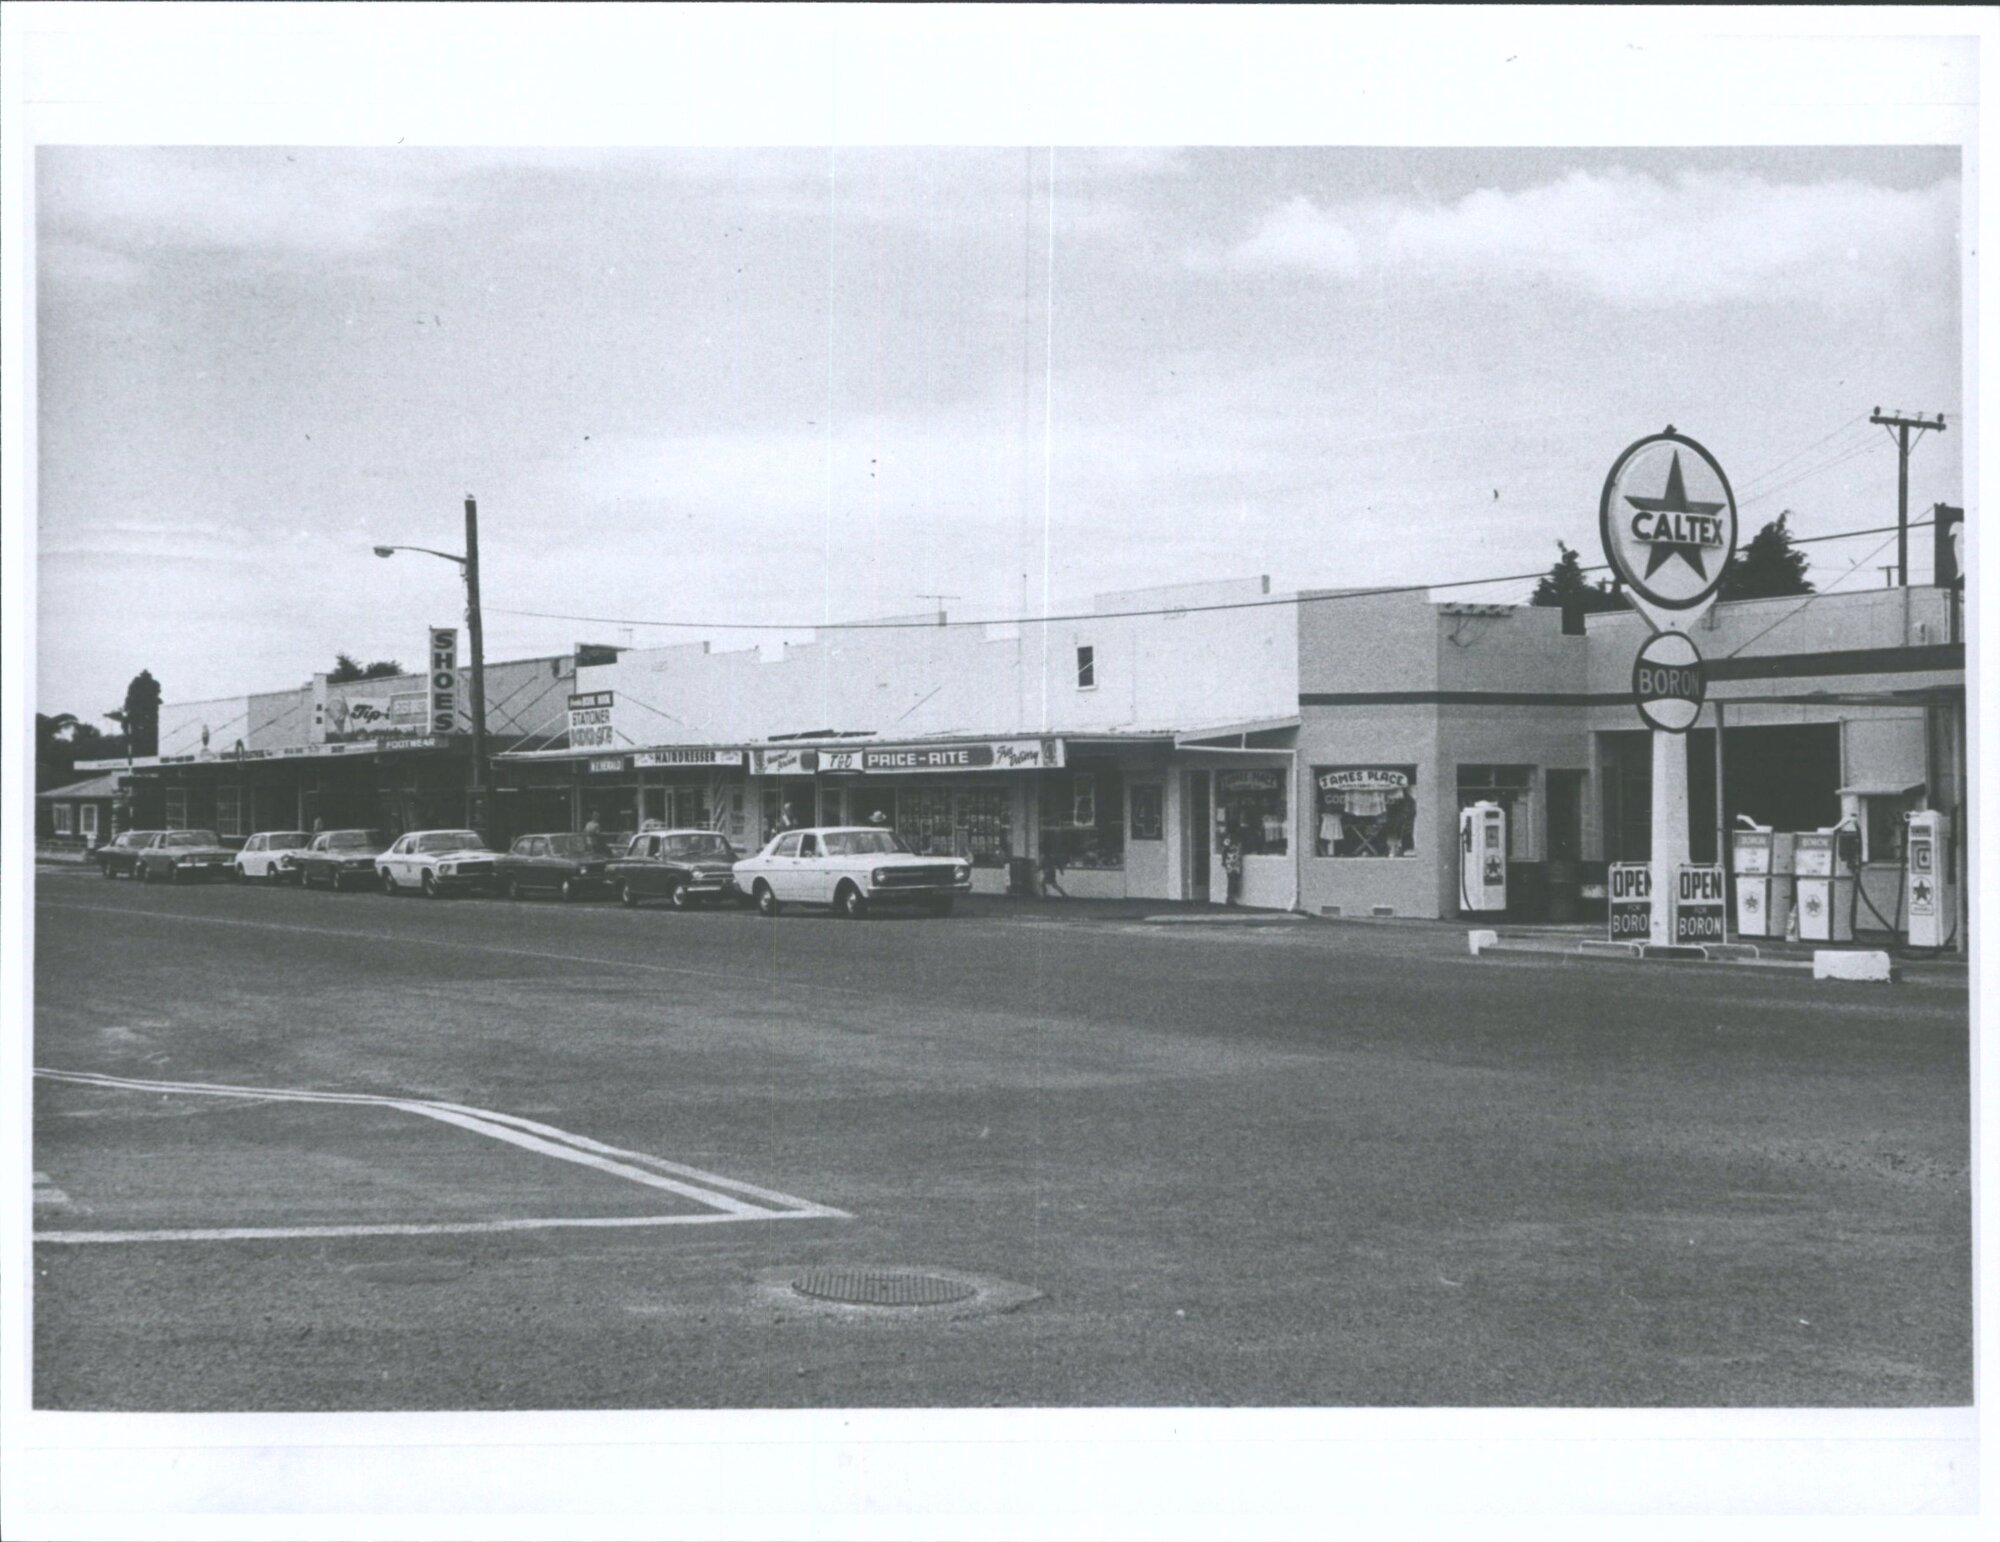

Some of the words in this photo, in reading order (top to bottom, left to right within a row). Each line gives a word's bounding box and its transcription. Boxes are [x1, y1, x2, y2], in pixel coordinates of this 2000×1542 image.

[1631, 511, 1724, 546] CALTEX
[434, 632, 454, 731] SHOES
[1638, 668, 1700, 697] BORON
[572, 709, 610, 726] STATIONER
[385, 738, 436, 749] FOOTWEAR
[655, 751, 716, 764] HAIRDRESSER
[867, 751, 969, 767] PRICE-RITE
[1321, 771, 1363, 787] JAMES
[1367, 771, 1405, 786] PLACE
[1680, 871, 1722, 899] OPEN
[1613, 914, 1648, 932] BORO
[1679, 917, 1722, 936] BORON
